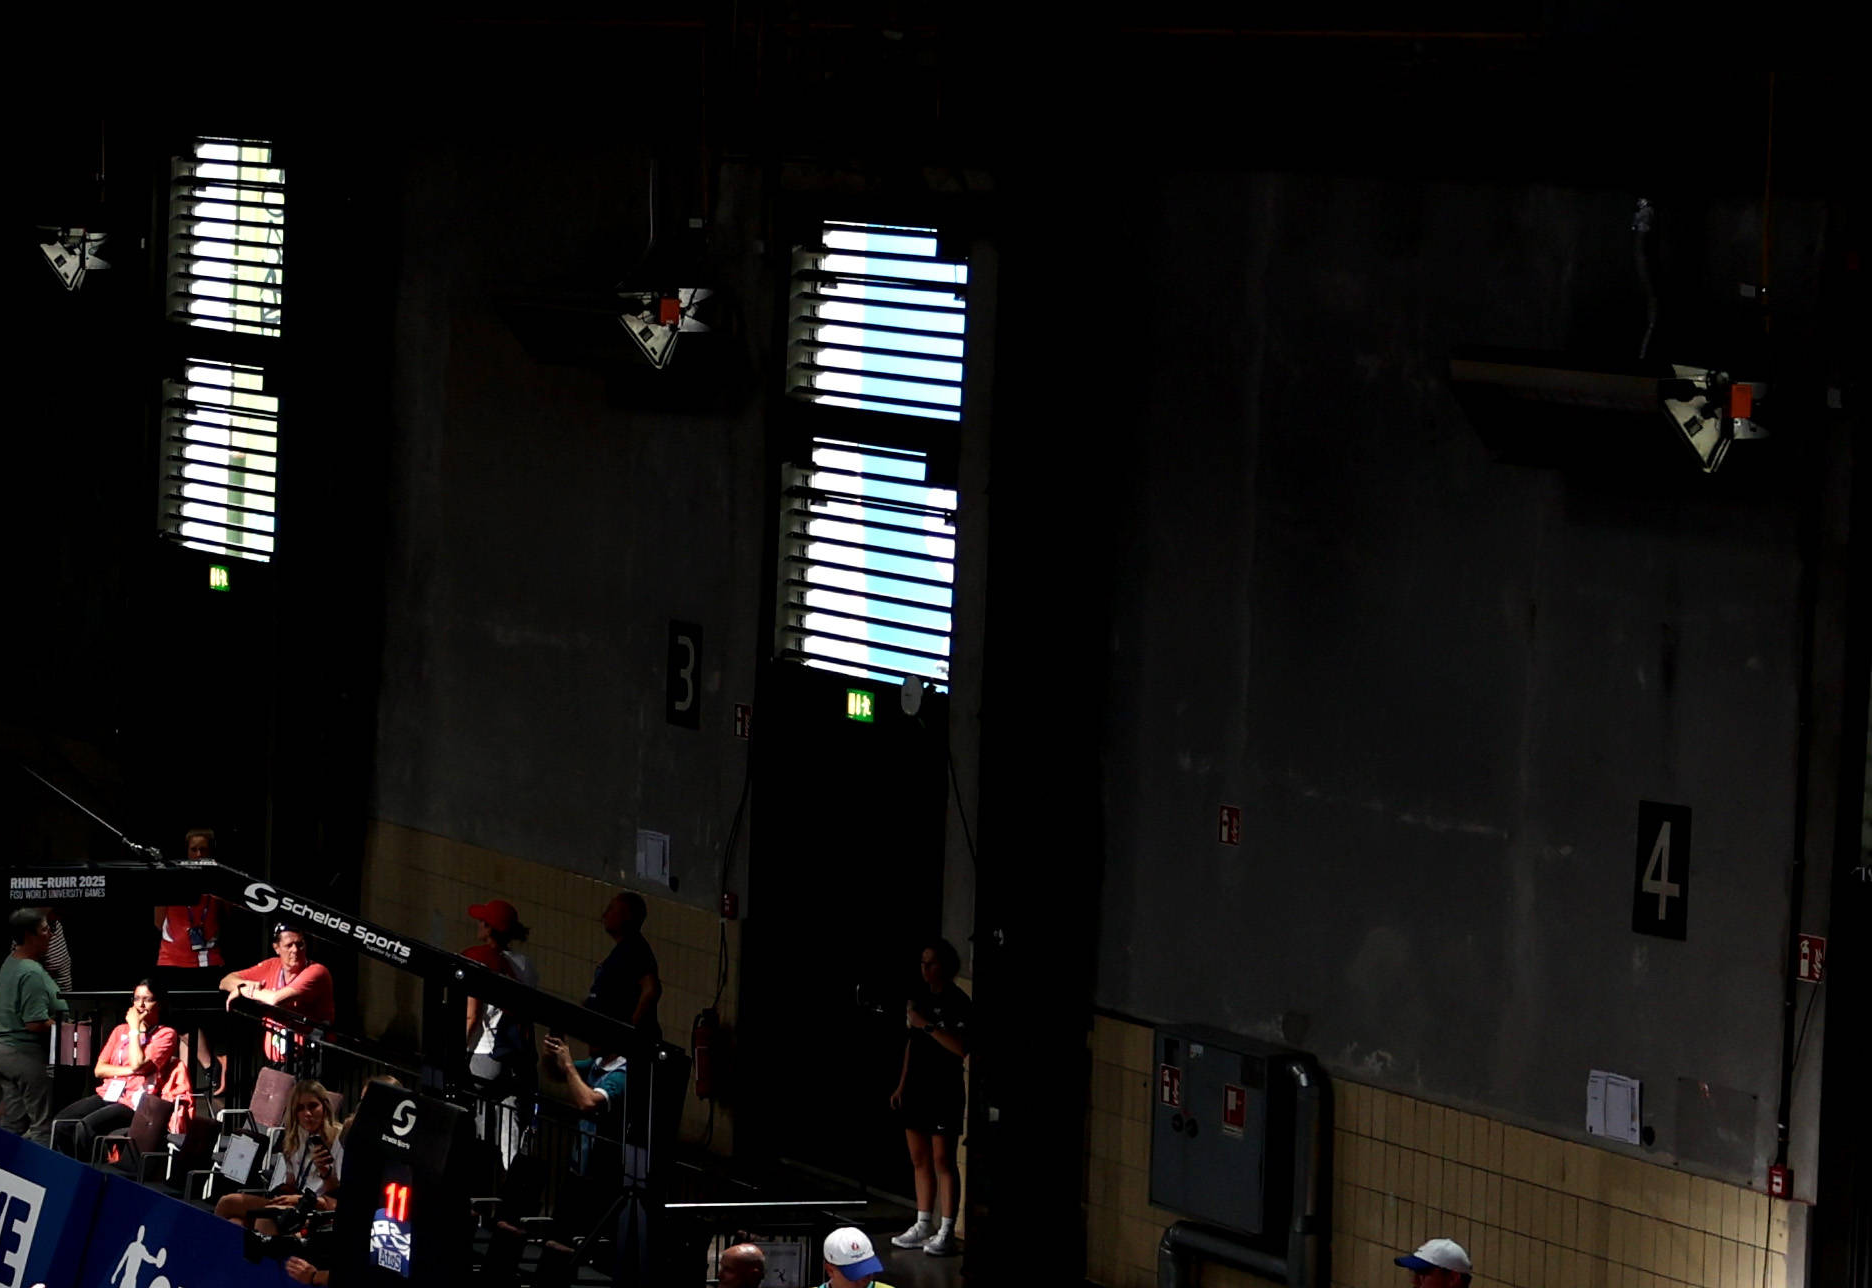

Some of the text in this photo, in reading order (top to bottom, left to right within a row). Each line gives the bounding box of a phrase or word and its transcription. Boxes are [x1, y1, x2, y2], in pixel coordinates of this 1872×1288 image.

[673, 634, 695, 712] 3
[9, 890, 24, 900] FISU
[24, 889, 46, 900] WORLD
[84, 887, 106, 898] GAMES
[10, 874, 106, 890] RHINE-RUHR 2025
[1640, 820, 1681, 921] 4
[279, 896, 352, 935] Schelde
[352, 921, 412, 959] Sports
[385, 1182, 409, 1223] 11
